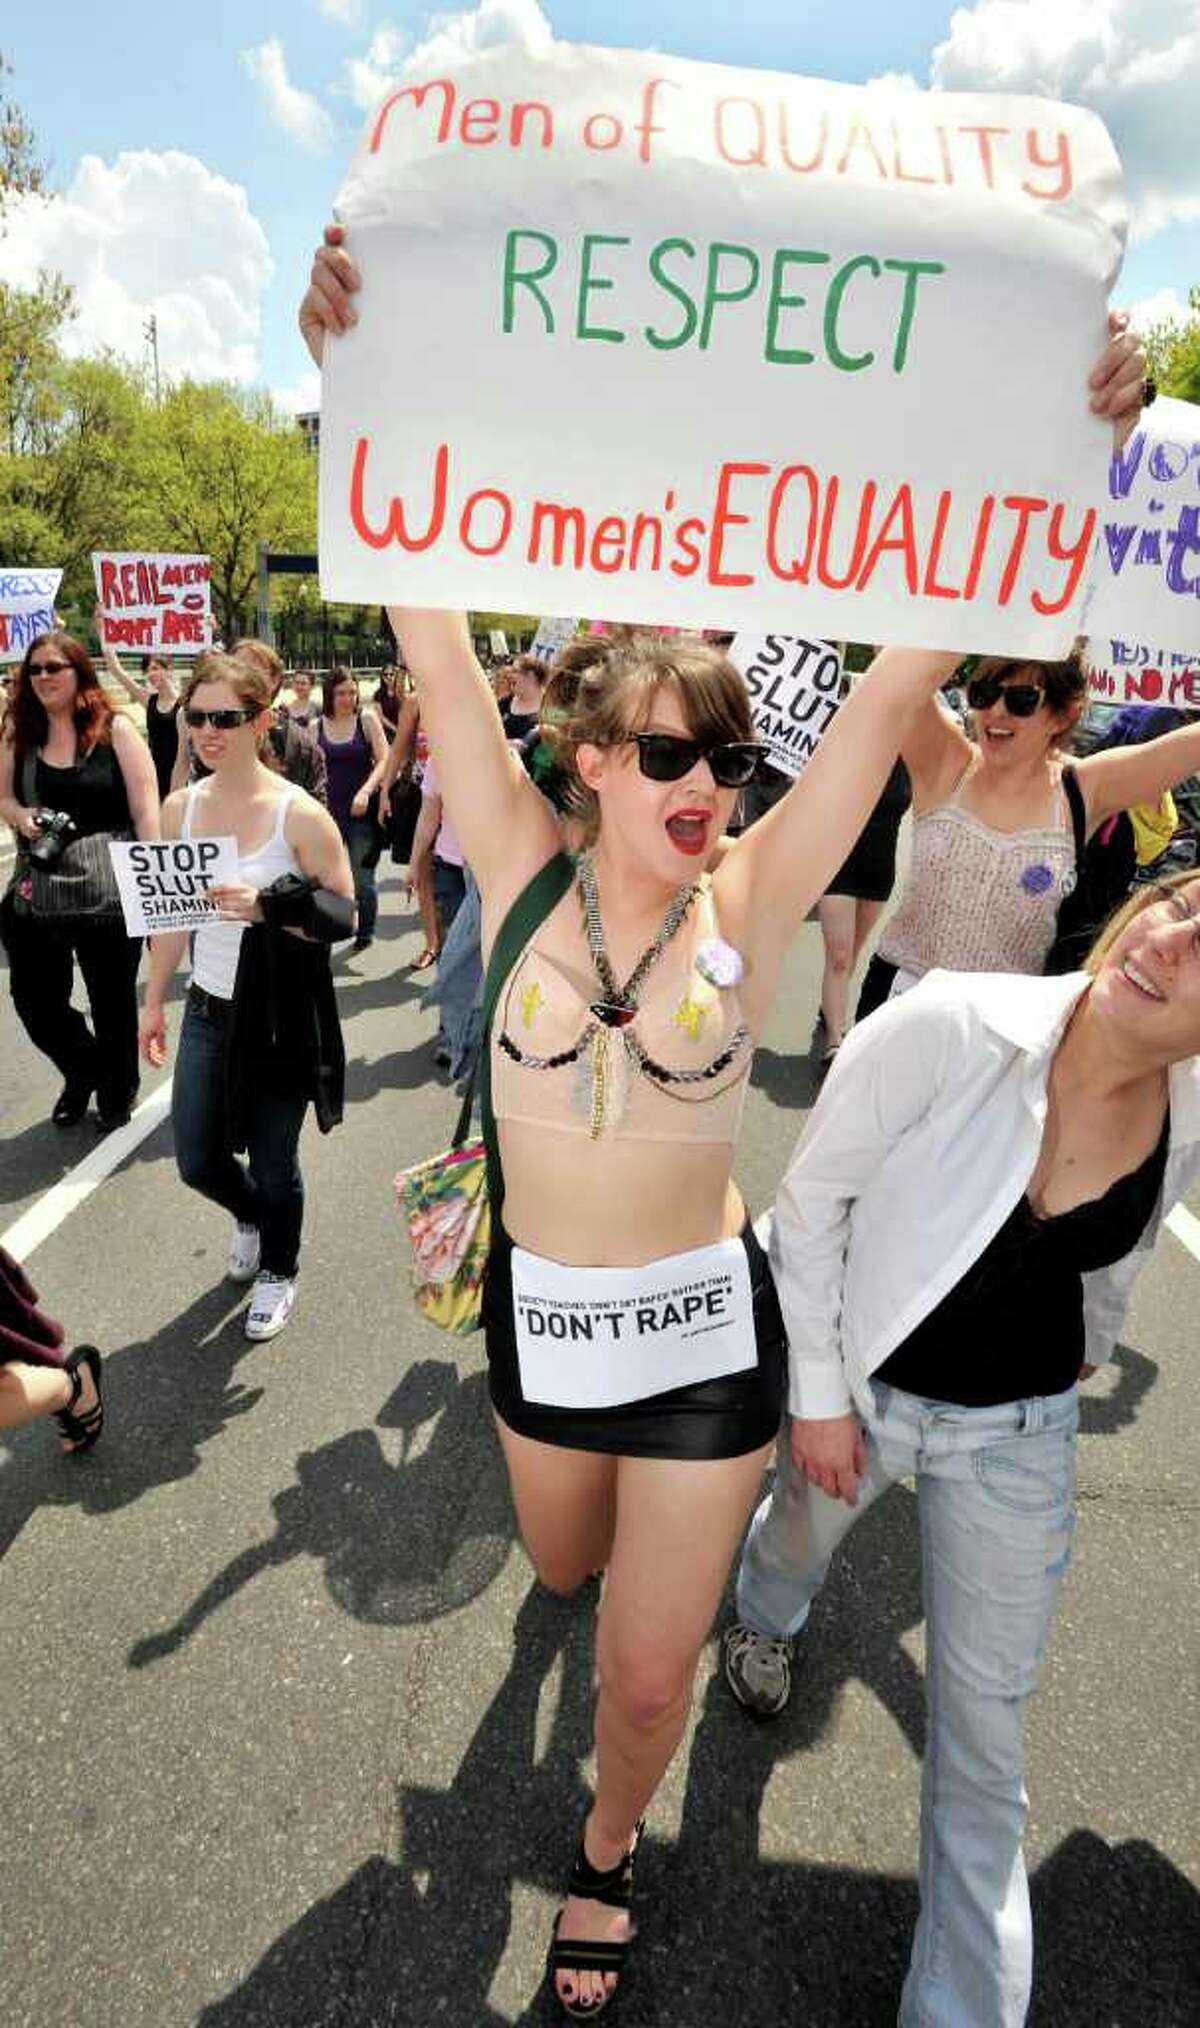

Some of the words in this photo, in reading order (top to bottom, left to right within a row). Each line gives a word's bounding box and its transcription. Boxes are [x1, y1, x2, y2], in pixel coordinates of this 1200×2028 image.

[371, 78, 552, 154] Men
[584, 79, 683, 163] of
[713, 96, 1073, 202] QUALITY
[502, 229, 946, 374] RESPECT
[349, 437, 708, 577] Women's
[707, 462, 1097, 616] EQUALITY
[757, 634, 841, 694] STO
[129, 842, 220, 873] STOP
[136, 875, 214, 897] SLUT
[142, 898, 222, 917] SHAMIN
[518, 1306, 625, 1341] 'DON'T
[635, 1285, 733, 1336] RAPE'
